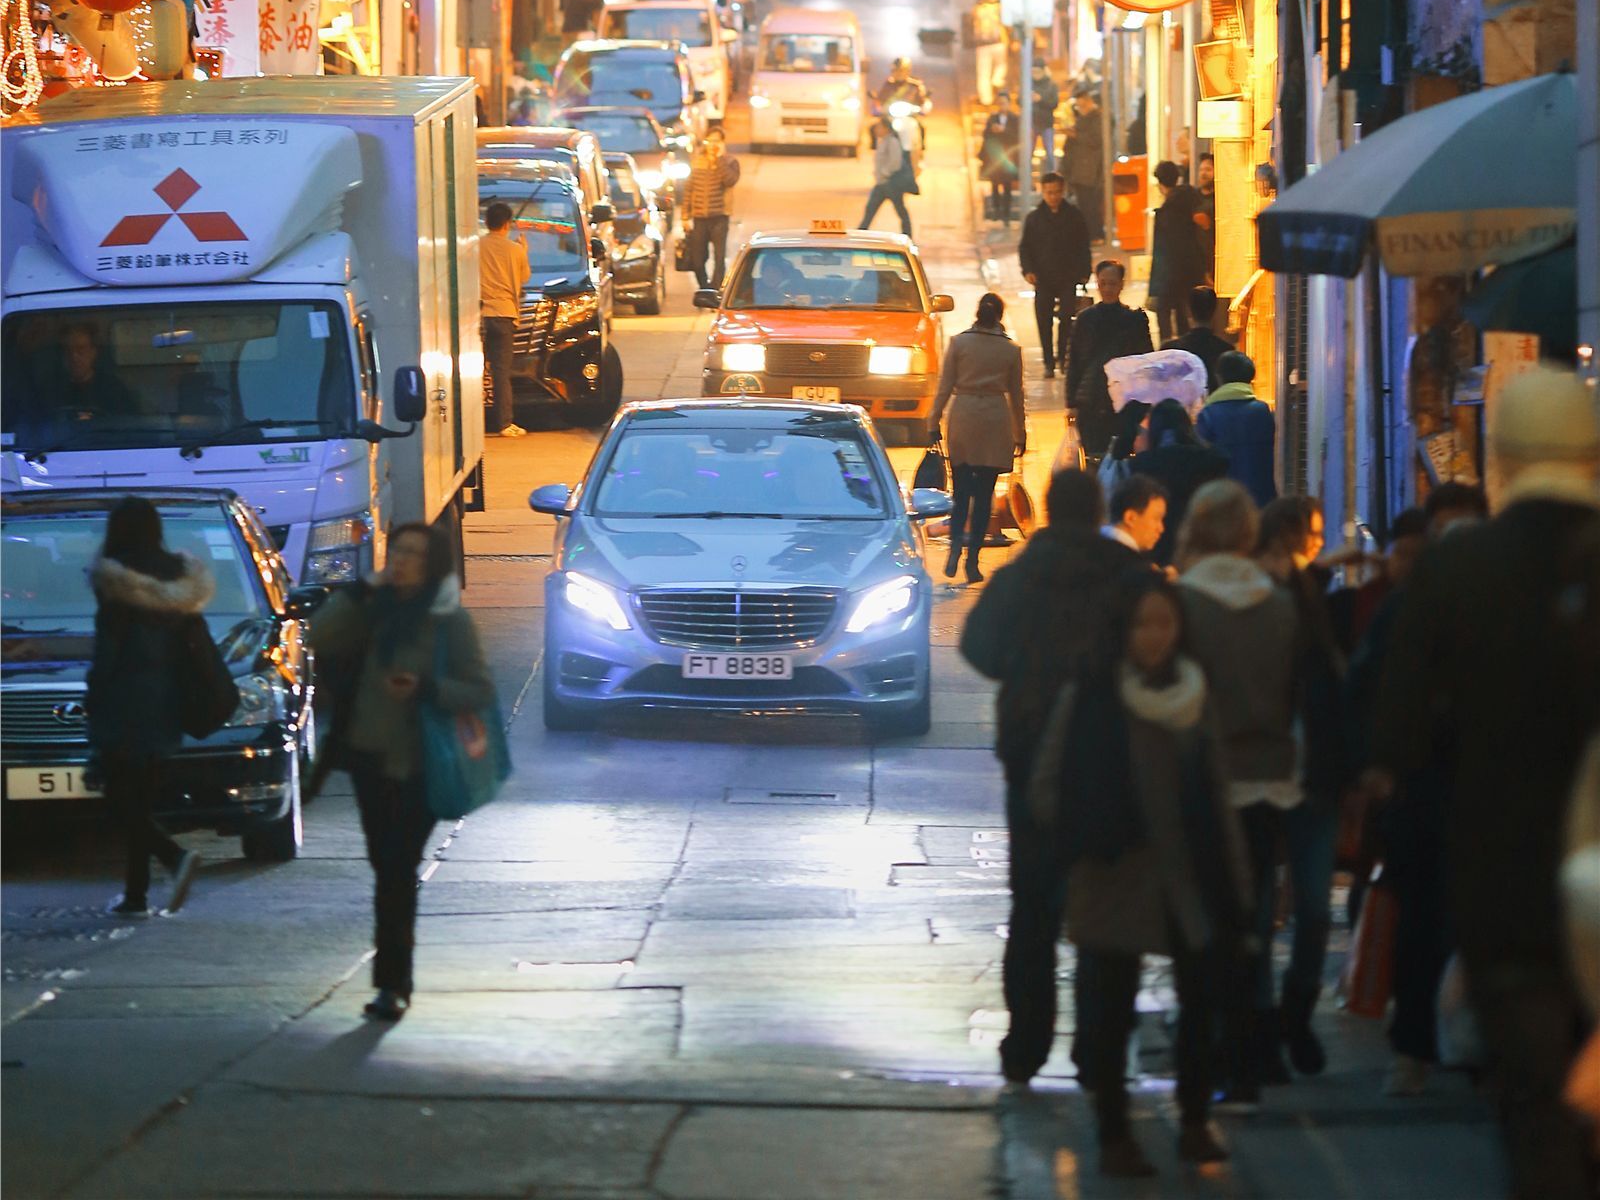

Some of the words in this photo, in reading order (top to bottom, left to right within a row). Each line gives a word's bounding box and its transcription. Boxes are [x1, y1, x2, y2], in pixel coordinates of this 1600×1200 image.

[811, 219, 842, 230] TAXI
[96, 251, 250, 272] 三菱鉛筆株式会社
[688, 656, 718, 675] FT
[725, 656, 785, 675] 8838
[38, 772, 73, 794] 51
